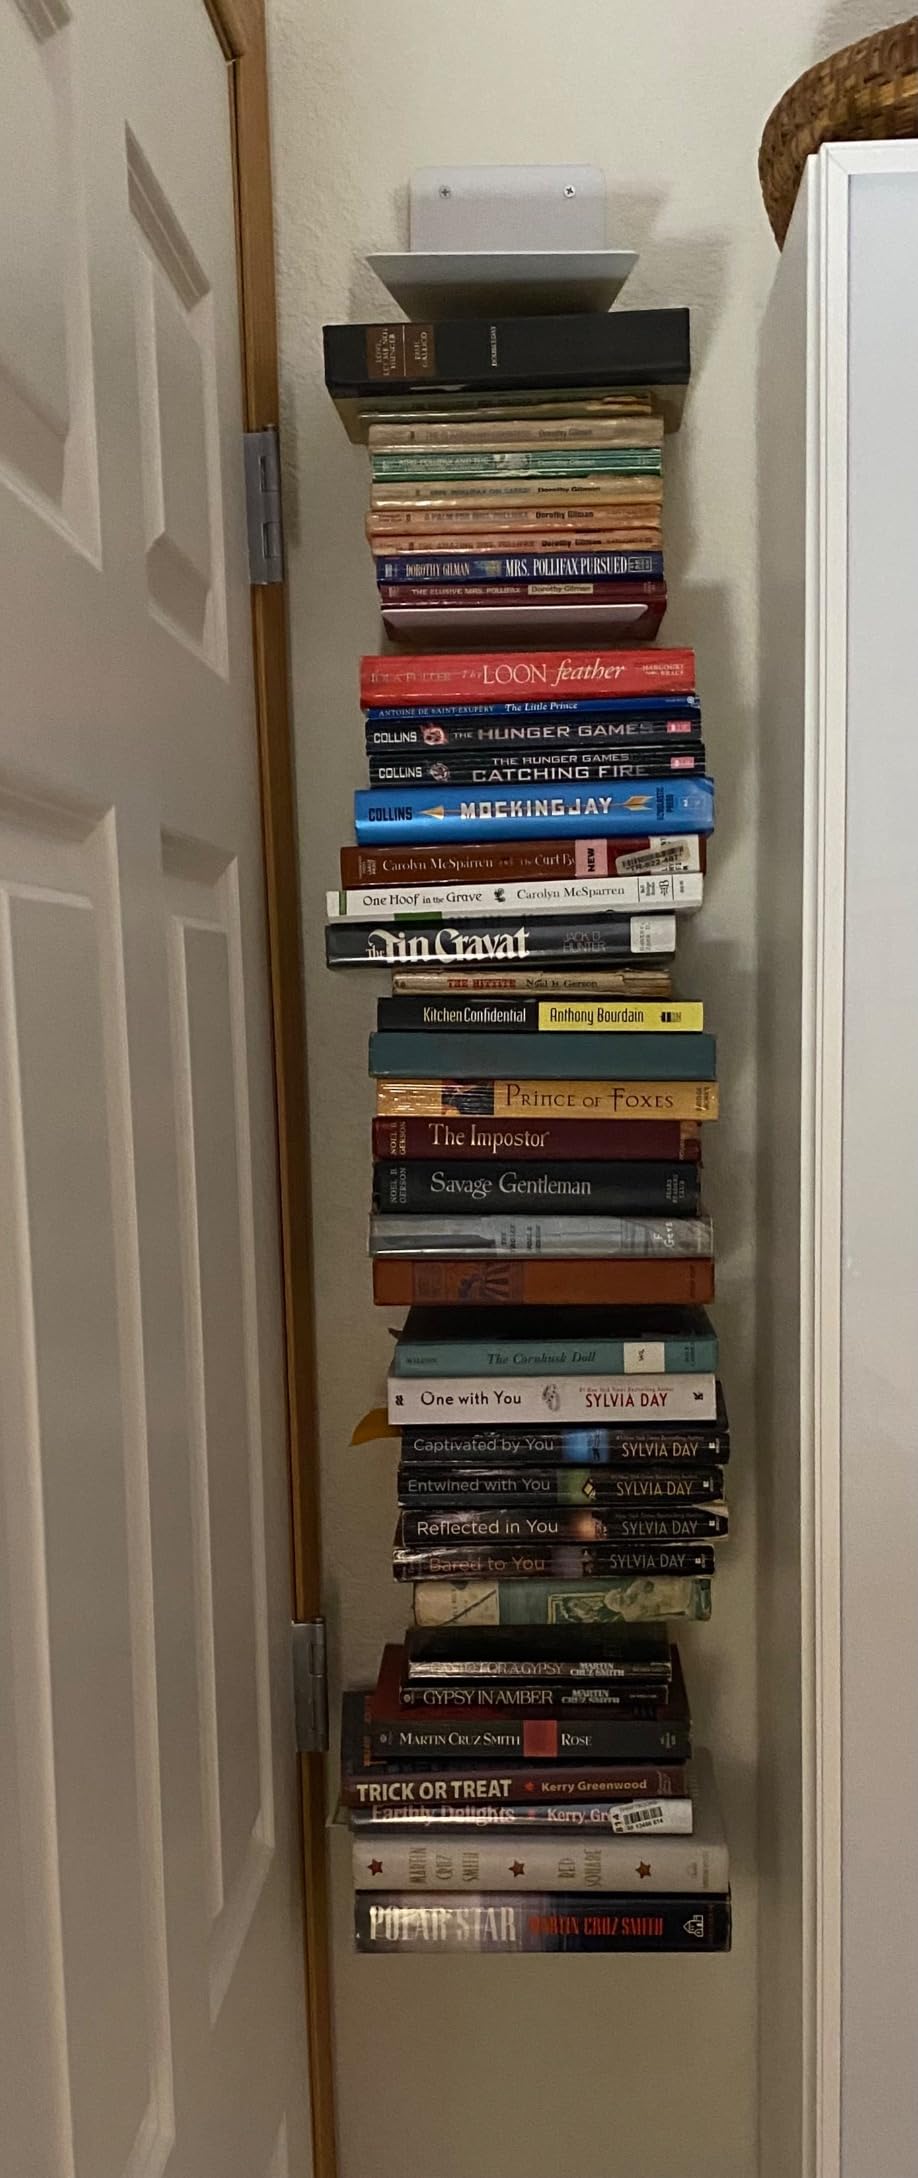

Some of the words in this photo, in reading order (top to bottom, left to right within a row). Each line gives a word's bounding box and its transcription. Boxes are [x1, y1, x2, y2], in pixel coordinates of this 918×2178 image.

[490, 326, 498, 367] DOUBLEDAY
[536, 510, 565, 520] Dorothy
[567, 510, 593, 518] Gilman
[542, 539, 571, 549] Dorothy
[575, 538, 601, 546] Gilman
[406, 562, 440, 577] DOROTHY
[442, 562, 470, 576] GILMAN
[505, 558, 530, 577] MRS.
[533, 557, 578, 577] POLLIFAX
[579, 556, 628, 575] PURSUED
[411, 587, 428, 596] THE
[429, 587, 463, 596] ELUSIVE
[465, 587, 484, 595] MRS.
[531, 585, 562, 594] Dorothy
[564, 583, 591, 593] Gilman
[482, 662, 547, 685] LOON
[549, 657, 625, 687] feather
[378, 708, 416, 718] ANTOINE
[505, 703, 518, 712] The
[524, 702, 547, 712] Little
[549, 701, 578, 711] Prince
[373, 731, 417, 744] COLLINS
[453, 732, 473, 740] THE
[477, 726, 570, 741] HUNGER
[577, 721, 654, 738] GAMES
[492, 757, 519, 766] THE
[522, 755, 578, 766] HUNGER
[581, 753, 630, 764] GAMES
[378, 766, 423, 780] COLLINS
[472, 766, 590, 783] CATCHING
[598, 764, 650, 780] FIRE
[368, 806, 413, 822] COLLINS
[460, 797, 612, 821] MOCKINGJAY
[382, 858, 428, 872] Carolyn
[430, 857, 494, 872] McSparren
[587, 848, 595, 873] NEW
[363, 895, 387, 906] One
[389, 893, 420, 906] Hoof
[422, 896, 432, 904] in
[432, 895, 444, 904] the
[446, 891, 483, 904] Grave
[517, 888, 560, 901] Carolyn
[563, 886, 625, 899] McSparren
[564, 931, 589, 943] JACK
[365, 944, 385, 960] The
[367, 929, 430, 964] Tin
[434, 926, 531, 965] Cravat
[562, 942, 607, 953] HUNTER
[563, 980, 598, 988] Gerson
[423, 1007, 463, 1023] Kitchen
[464, 1007, 527, 1023] Confidential
[549, 1007, 594, 1026] Anthony
[597, 1008, 644, 1023] Bourdain
[607, 1088, 675, 1112] FOXES
[398, 1121, 406, 1156] GERSON
[428, 1123, 465, 1146] The
[470, 1124, 551, 1155] Impostor
[389, 1181, 398, 1204] NOEL
[398, 1168, 406, 1204] GERSON
[430, 1172, 493, 1200] Savage
[498, 1171, 592, 1196] Gentleman
[487, 1353, 509, 1365] The
[512, 1352, 567, 1365] Cornhusk
[571, 1351, 597, 1363] Doll
[420, 1391, 454, 1406] One
[458, 1391, 489, 1405] with
[493, 1390, 522, 1405] You
[586, 1393, 635, 1408] SYLVIA
[640, 1393, 668, 1407] DAY
[413, 1438, 497, 1453] Captivated
[501, 1438, 520, 1453] by
[525, 1438, 554, 1451] You
[621, 1442, 668, 1457] SYLVIA
[672, 1442, 699, 1456] DAY
[408, 1479, 479, 1492] Entwined
[484, 1479, 516, 1491] with
[522, 1478, 551, 1491] You
[616, 1481, 662, 1497] SYLVIA
[667, 1481, 693, 1495] DAY
[417, 1520, 500, 1536] Reflected
[505, 1520, 520, 1534] in
[526, 1520, 559, 1533] You
[621, 1520, 668, 1536] SYLVIA
[672, 1520, 699, 1535] DAY
[429, 1557, 481, 1572] Bared
[488, 1558, 506, 1571] to
[511, 1556, 545, 1571] You
[609, 1554, 656, 1569] SYLVIA
[660, 1554, 686, 1568] DAY
[510, 1663, 521, 1674] A
[521, 1662, 561, 1675] GYPSY
[423, 1690, 475, 1705] GYPSY
[478, 1691, 493, 1704] IN
[495, 1690, 554, 1704] AMBER
[572, 1689, 609, 1697] MARTIN
[400, 1732, 447, 1746] MARTIN
[448, 1732, 482, 1746] CRUZ
[483, 1732, 520, 1745] SMITH
[561, 1733, 592, 1746] ROSE
[356, 1782, 414, 1802] TRICK
[419, 1781, 447, 1799] OR
[451, 1779, 512, 1798] TREAT
[542, 1781, 575, 1793] Kerry
[577, 1780, 647, 1792] Greenwood
[372, 1804, 433, 1826] Earthly
[441, 1804, 515, 1826] Delights
[547, 1808, 586, 1824] Kerry
[408, 1847, 427, 1884] MARTIN
[435, 1854, 454, 1881] CRUZ
[462, 1852, 480, 1882] SMITH
[558, 1857, 576, 1879] RED
[583, 1849, 602, 1888] SQUARE
[369, 1905, 453, 1941] POLAR
[456, 1906, 517, 1941] STAR
[528, 1914, 580, 1936] MARTIN
[584, 1915, 620, 1936] CRUZ
[621, 1916, 664, 1937] SMITH
